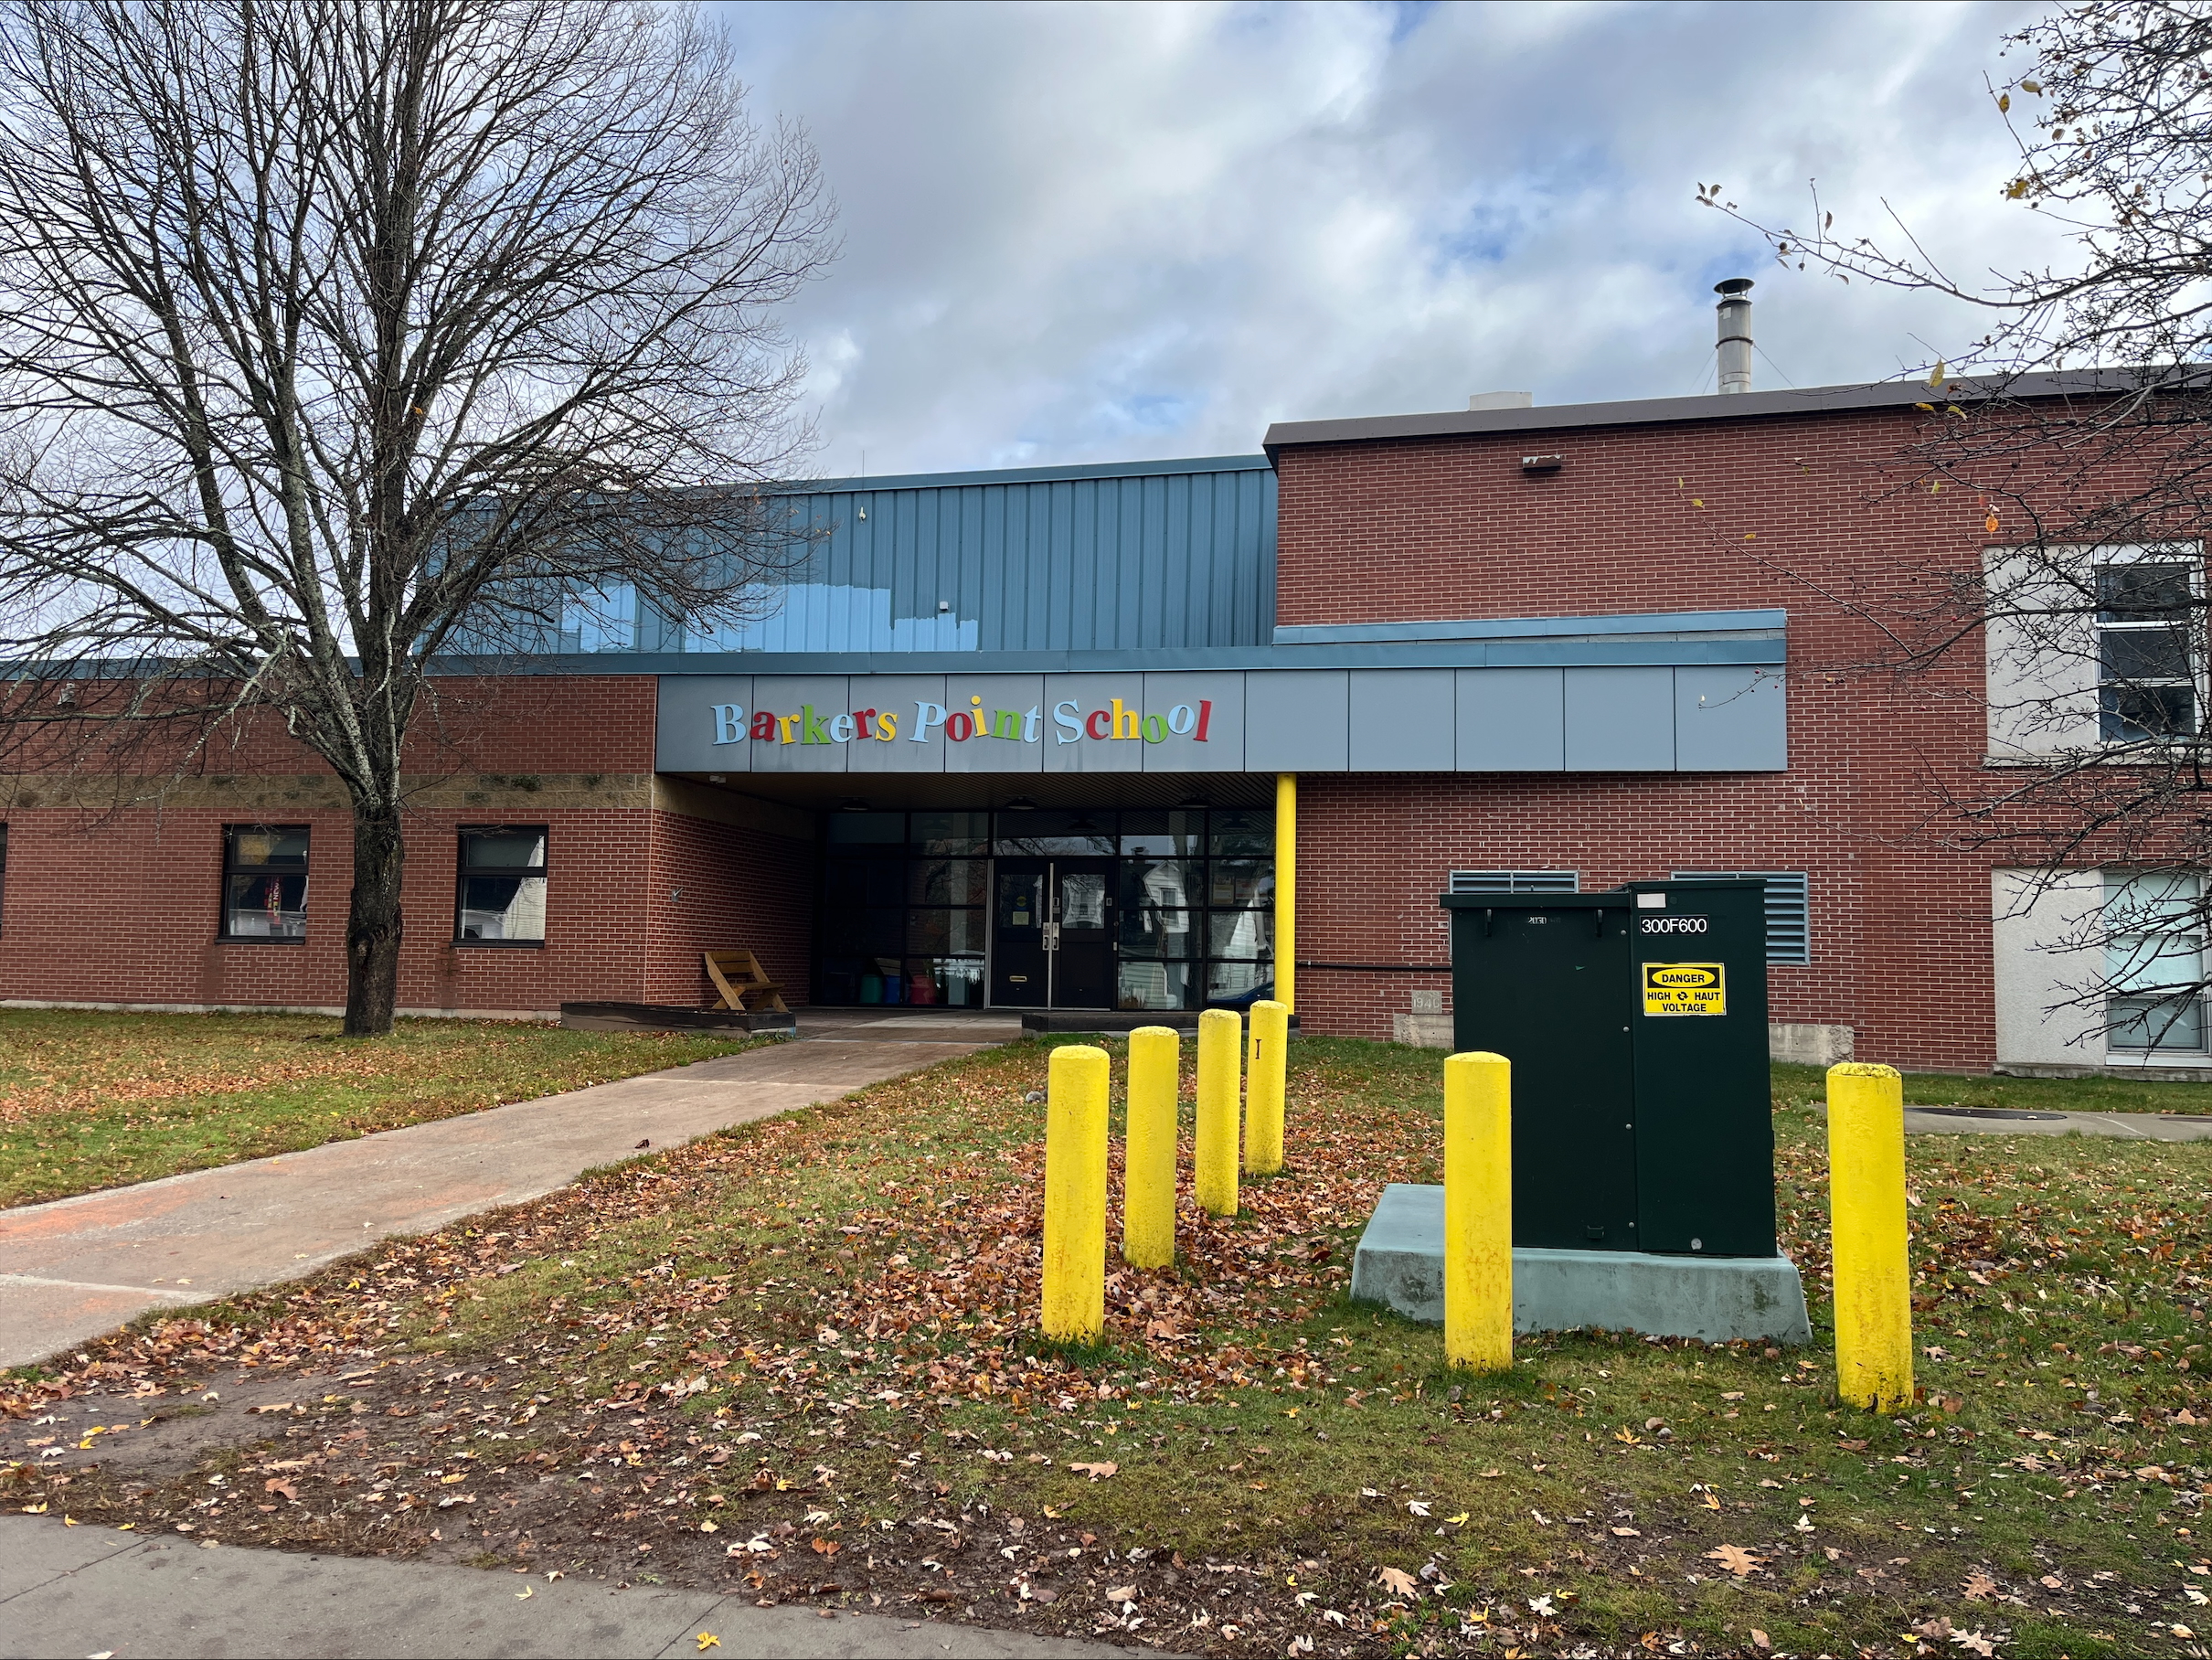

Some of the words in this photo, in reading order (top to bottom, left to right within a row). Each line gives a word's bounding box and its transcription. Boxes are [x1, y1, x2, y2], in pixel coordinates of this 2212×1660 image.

[711, 704, 898, 745] Barkers
[909, 695, 1041, 743] Point
[1053, 698, 1212, 746] School
[1642, 919, 1707, 932] 300F600
[1662, 974, 1705, 983] DANGER
[1647, 992, 1671, 1001] HIGH
[1695, 992, 1720, 1001] HAUT
[1662, 1004, 1707, 1012] VOLTAGE
